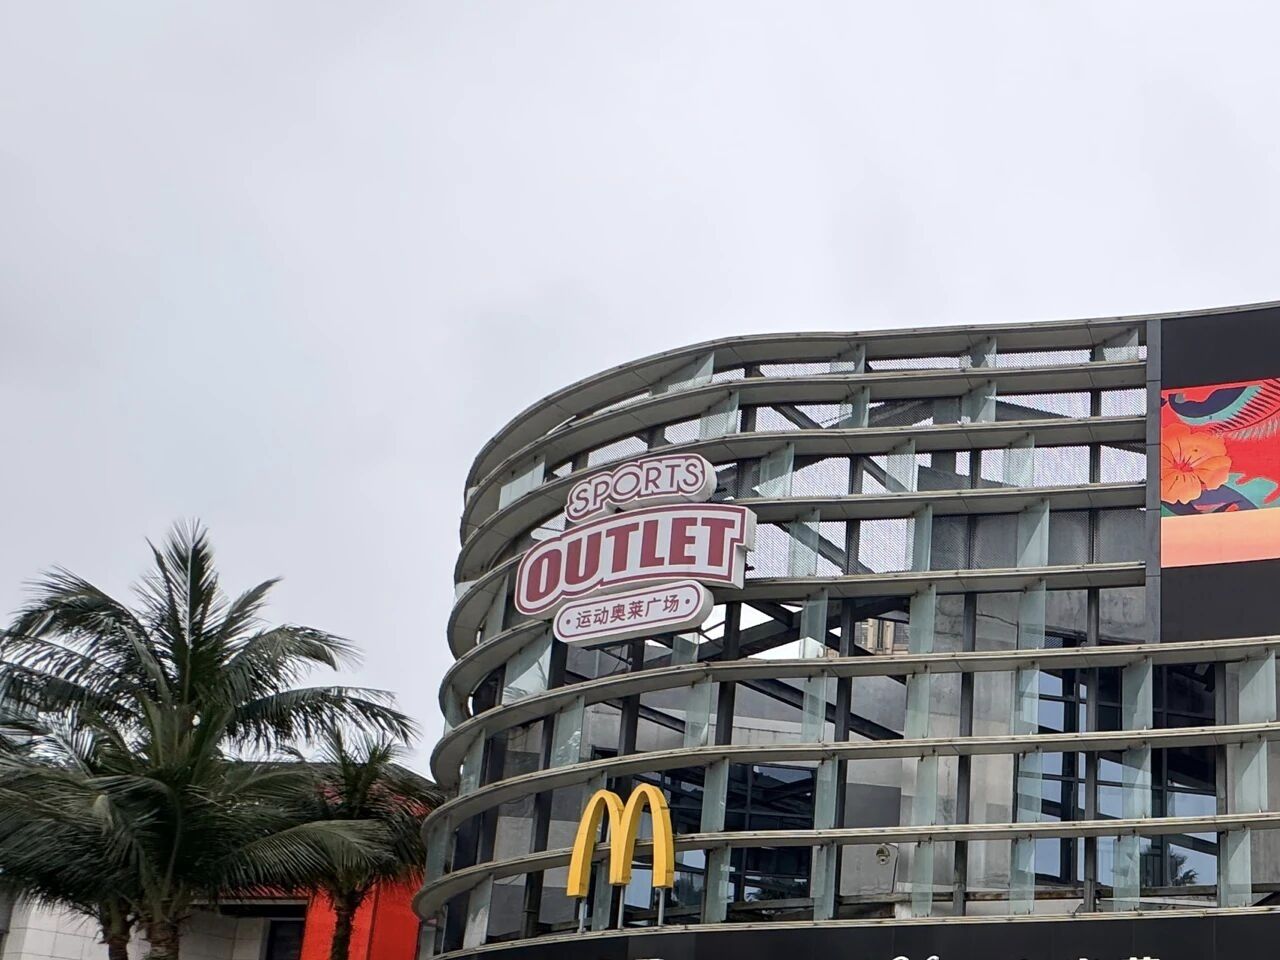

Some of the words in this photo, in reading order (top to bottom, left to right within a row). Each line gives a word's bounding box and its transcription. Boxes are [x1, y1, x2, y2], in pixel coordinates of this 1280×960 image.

[573, 458, 702, 515] SPORTS
[526, 517, 736, 603] OUTLET
[575, 594, 680, 630] 运动奥莱广场
